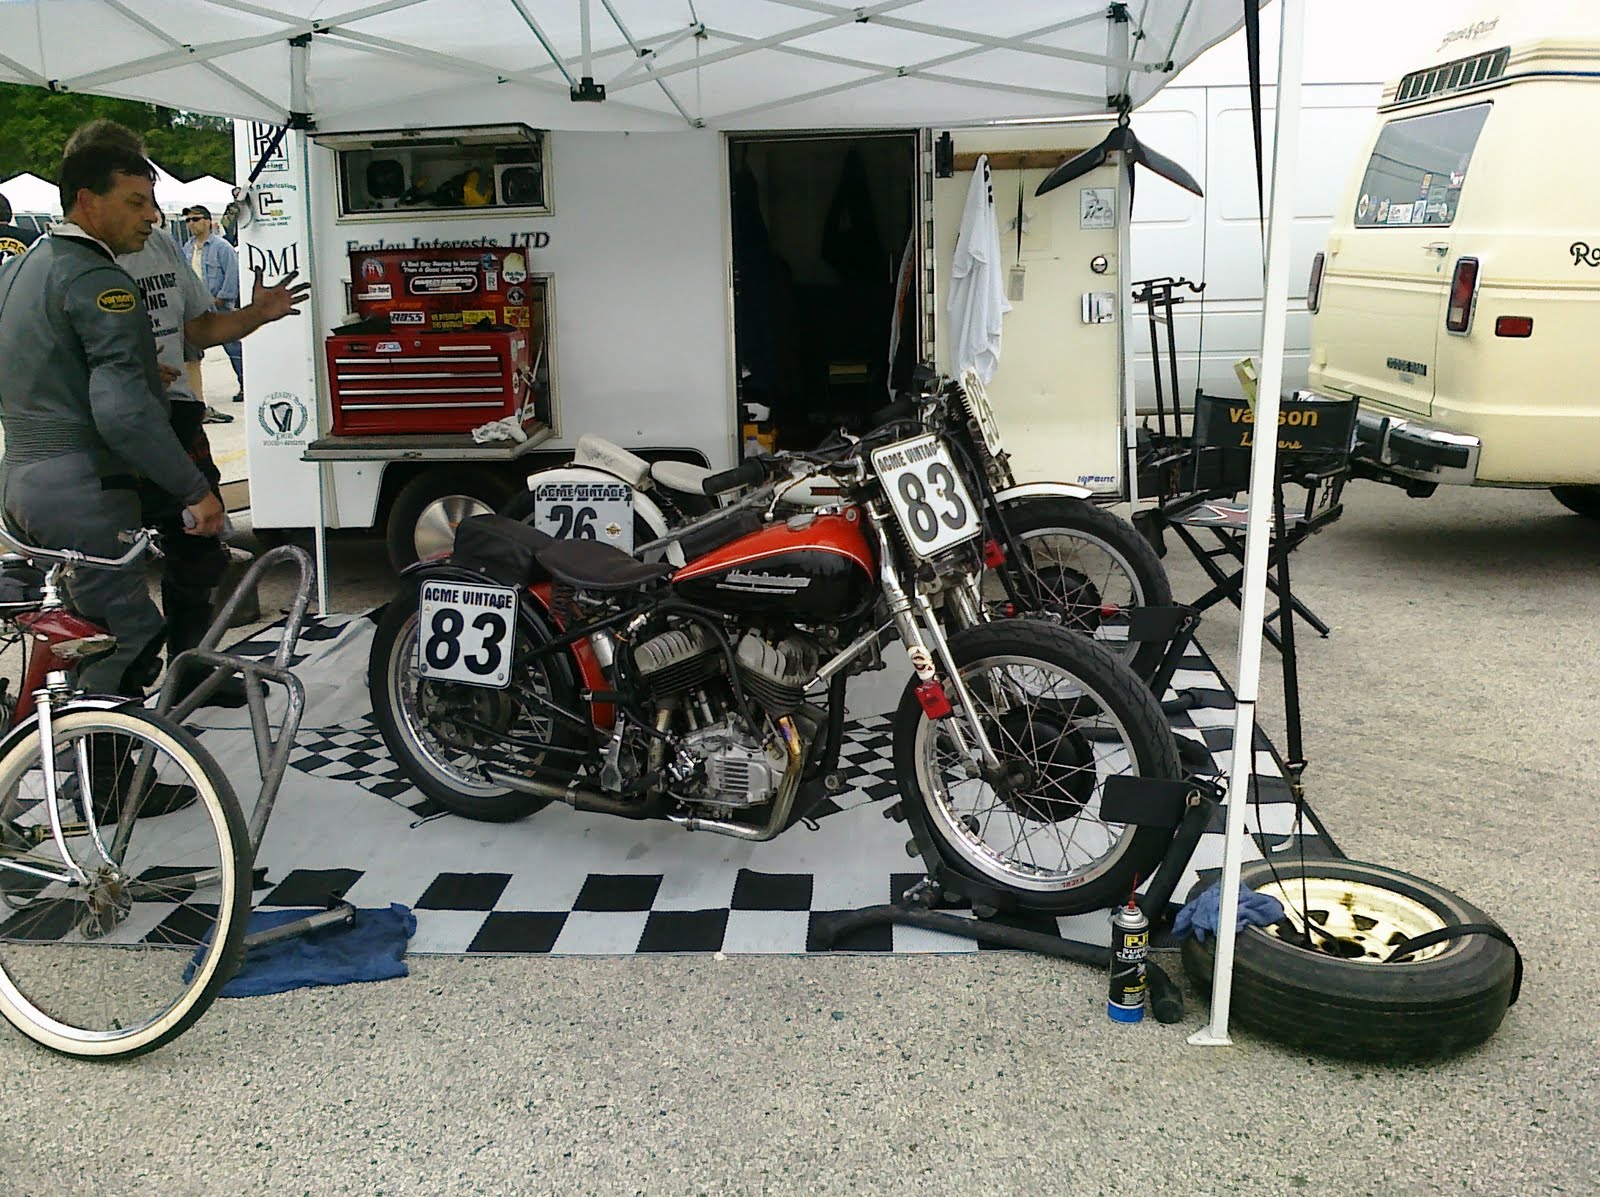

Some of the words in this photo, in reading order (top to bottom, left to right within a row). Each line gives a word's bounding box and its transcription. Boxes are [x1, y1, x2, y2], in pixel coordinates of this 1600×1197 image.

[510, 231, 550, 249] LTD
[246, 241, 300, 277] DMI
[144, 293, 168, 311] ING
[1229, 408, 1318, 427] vason
[1240, 432, 1303, 450] Lers
[876, 451, 907, 474] ACME
[905, 440, 942, 465] VINTAGE
[541, 488, 574, 497] ACME
[577, 488, 625, 497] VINTAGE
[898, 462, 966, 543] 83
[550, 504, 597, 541] 26
[424, 587, 459, 603] ACME
[462, 590, 513, 610] VINTAGE
[425, 607, 507, 676] 83
